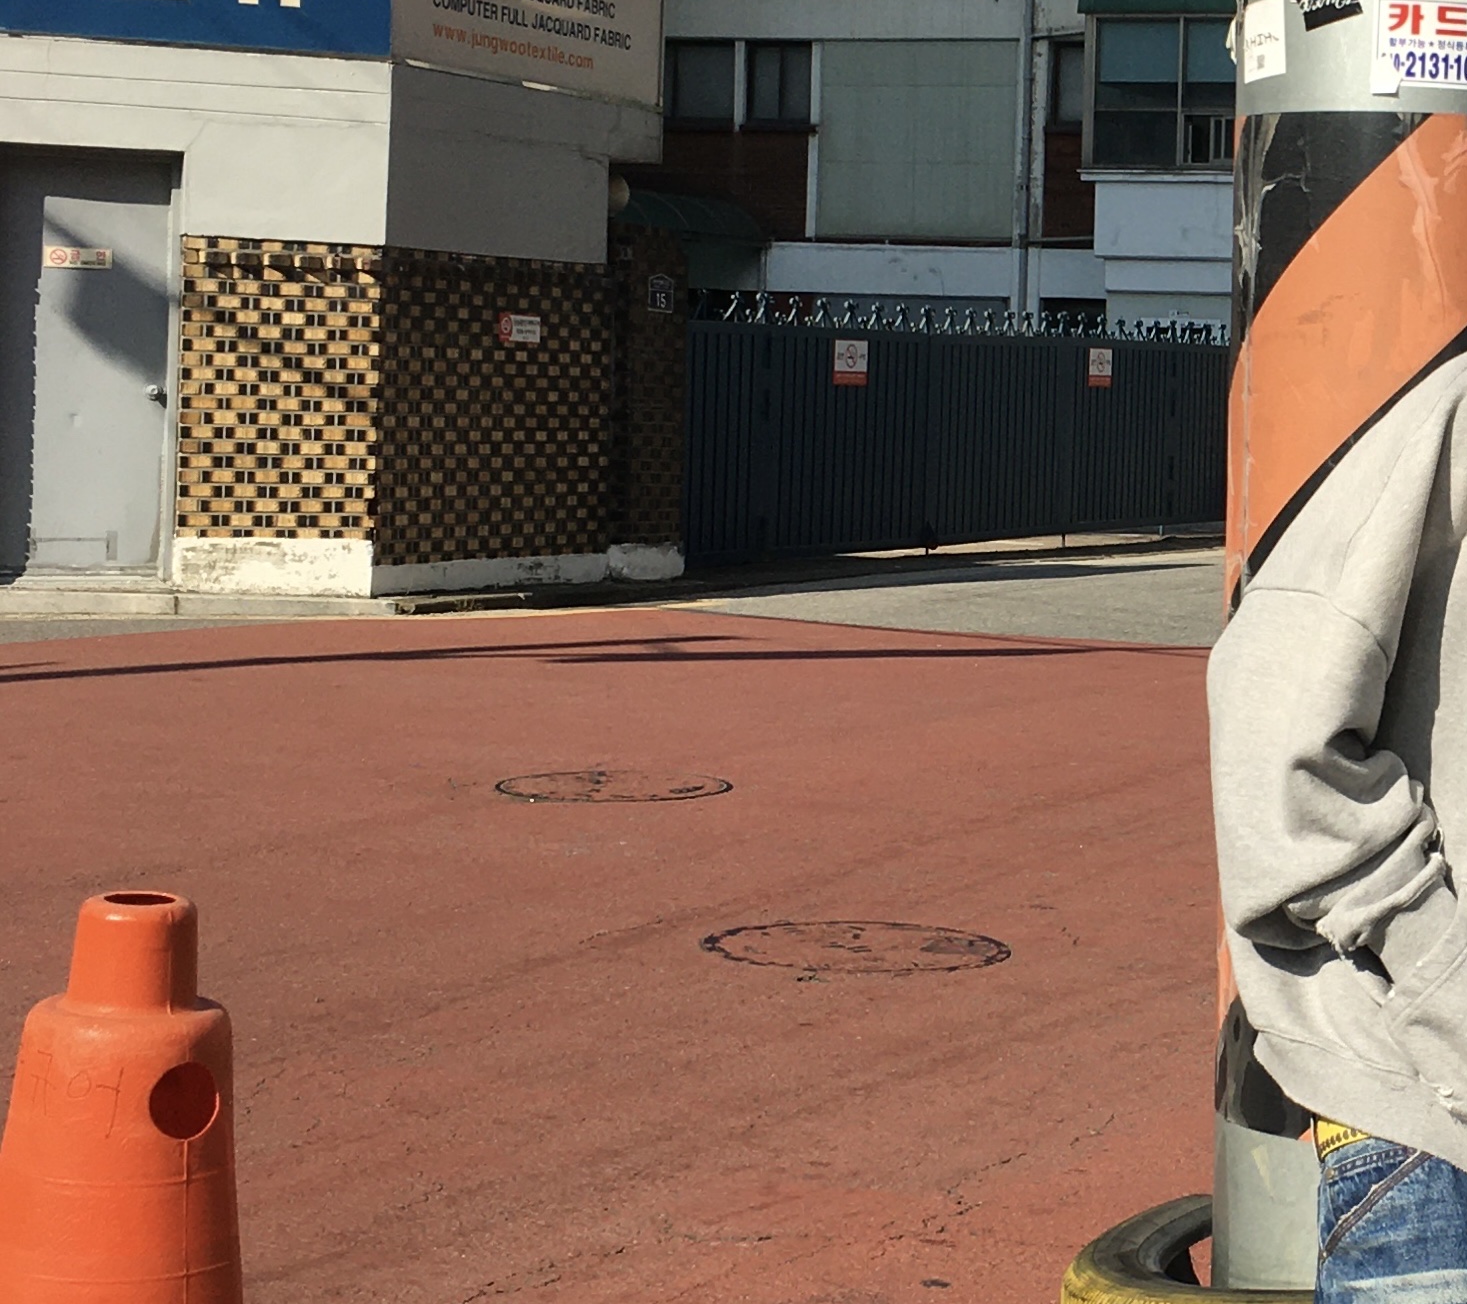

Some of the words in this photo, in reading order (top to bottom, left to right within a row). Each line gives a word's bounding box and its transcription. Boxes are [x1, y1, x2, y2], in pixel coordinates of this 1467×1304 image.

[577, 0, 616, 19] FABRIC
[501, 5, 529, 28] FULL
[531, 12, 592, 42] JACQUARD
[593, 27, 632, 51] FABRIC
[433, 23, 595, 70] www.jungwootextile.com
[1389, 37, 1426, 49] 할부가능
[656, 293, 667, 309] 15
